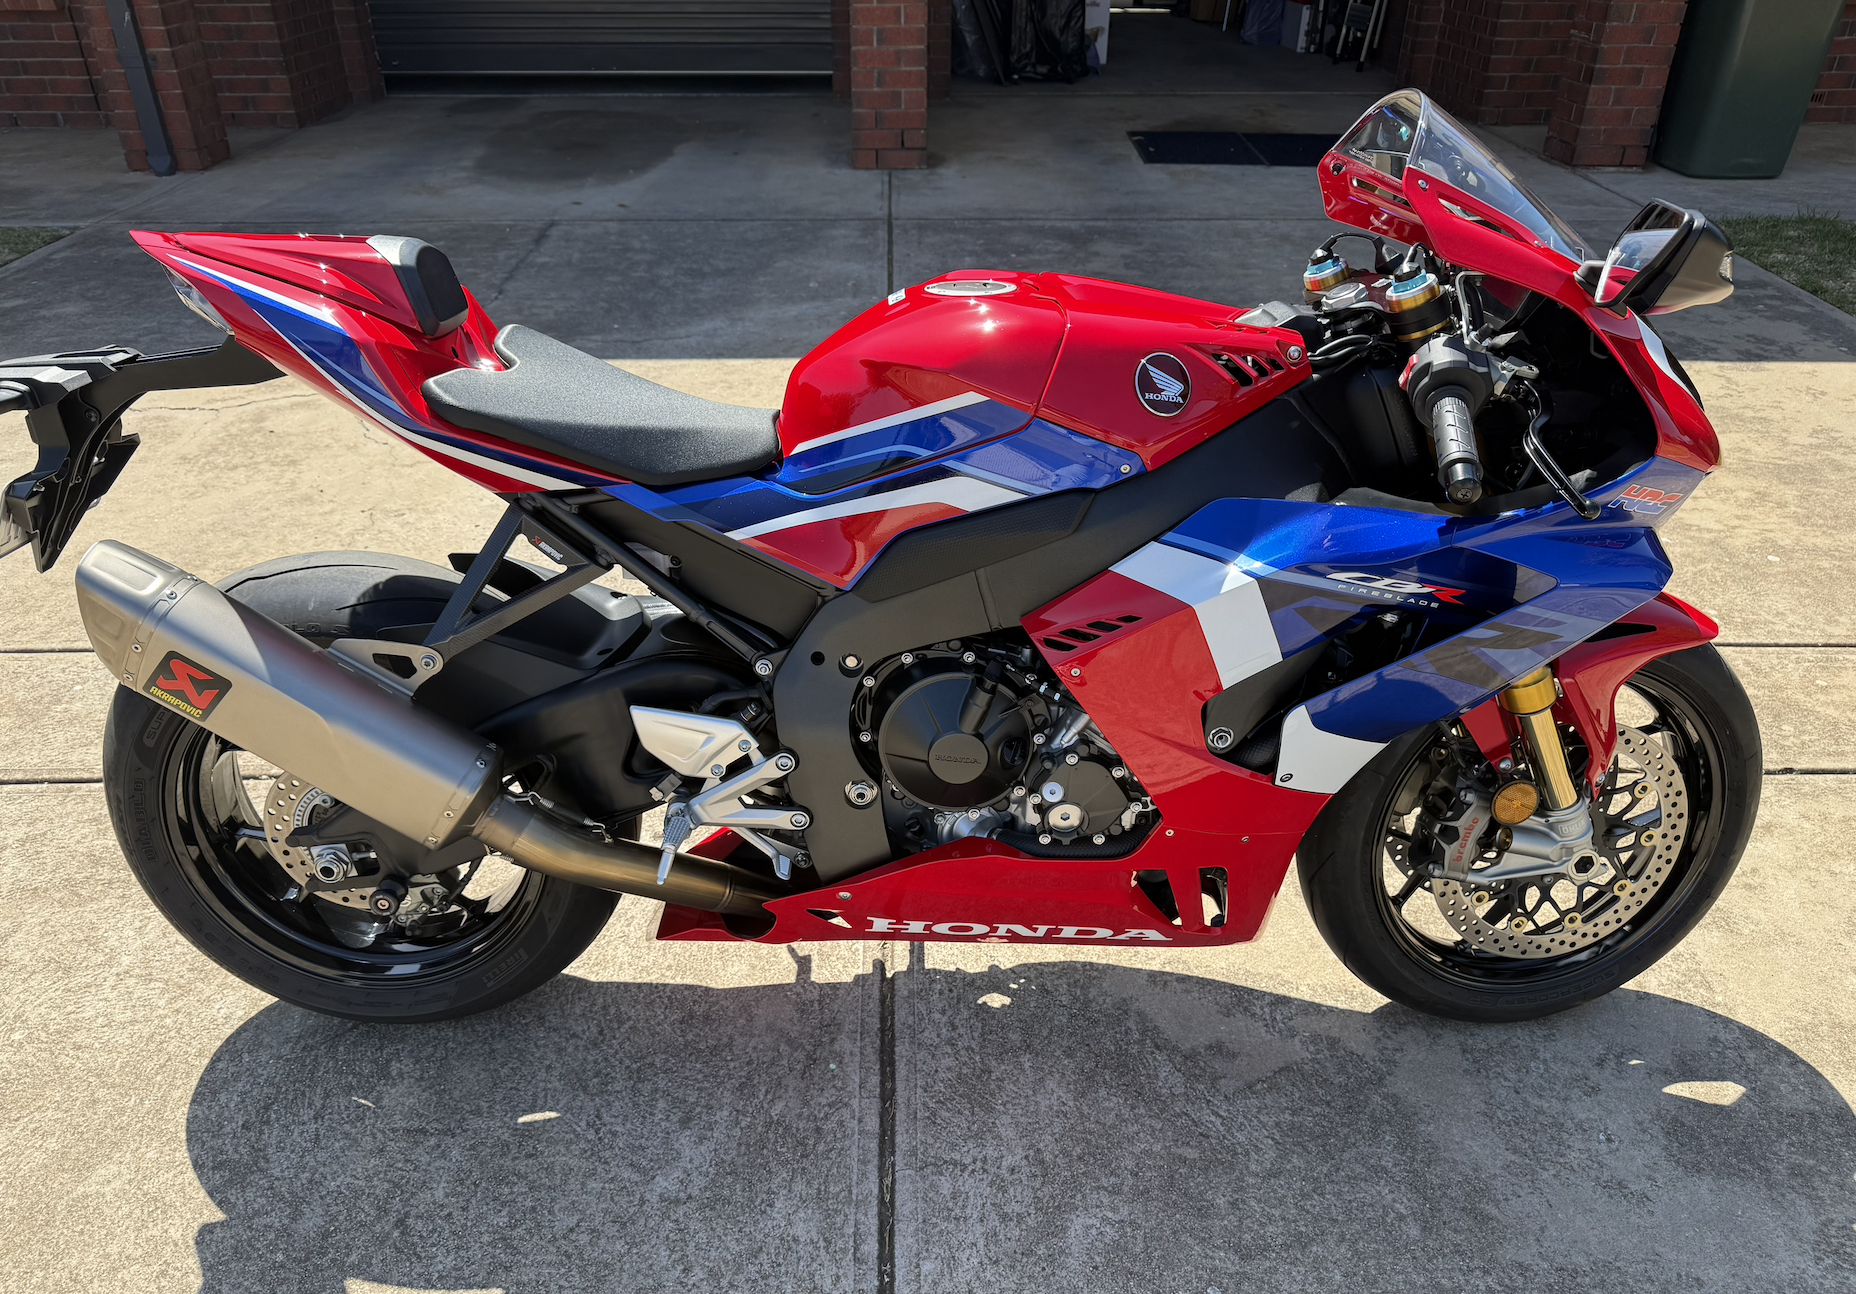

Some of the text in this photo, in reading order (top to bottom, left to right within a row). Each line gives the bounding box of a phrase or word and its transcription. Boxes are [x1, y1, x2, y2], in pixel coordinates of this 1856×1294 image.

[1144, 392, 1184, 404] HONDA
[1608, 484, 1683, 515] HRC
[1326, 572, 1466, 605] CBR
[1338, 584, 1440, 609] FIREBLADE
[935, 754, 981, 764] HONDA
[132, 777, 158, 863] DIABLO
[1452, 816, 1480, 863] brembo
[865, 916, 1173, 941] HONDA
[481, 947, 529, 988] PIRELLI
[1467, 969, 1616, 1006] SUPERCORSA SP
